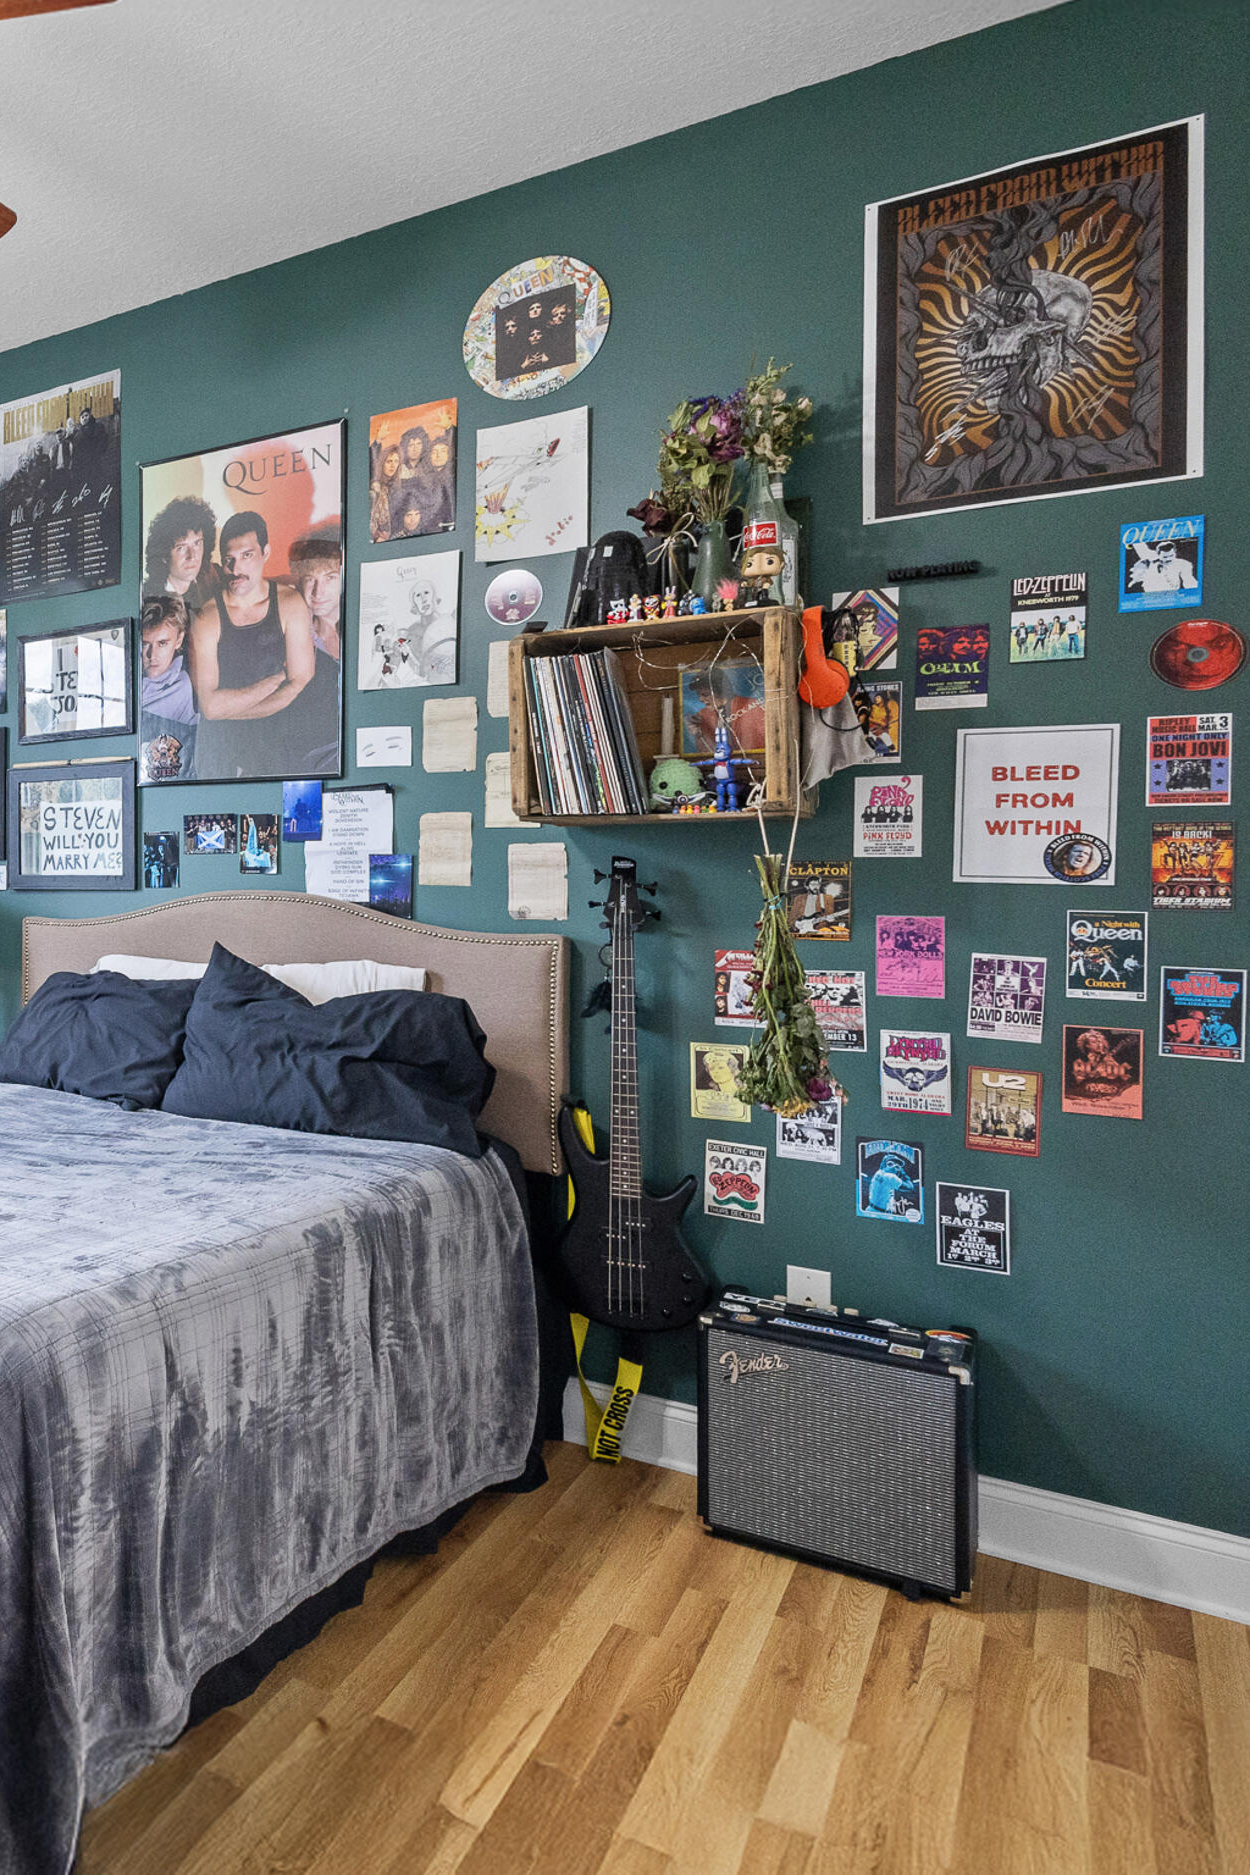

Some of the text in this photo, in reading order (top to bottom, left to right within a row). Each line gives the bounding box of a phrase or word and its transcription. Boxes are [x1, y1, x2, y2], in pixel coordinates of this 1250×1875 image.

[498, 267, 554, 305] QUEEN
[222, 444, 332, 495] QUEEN
[1122, 519, 1201, 549] QUEEN
[920, 661, 982, 675] CREAM
[1219, 716, 1228, 728] 3
[1151, 732, 1227, 742] ONE NIGHT ONLY
[1153, 741, 1226, 758] BON JOVI
[992, 765, 1080, 781] BLEED
[996, 792, 1074, 808] FROM
[44, 806, 121, 830] STEVEN
[985, 820, 1081, 835] WITHIN
[43, 832, 118, 850] WILL YOU
[43, 852, 122, 871] MARRY ME?
[790, 866, 848, 876] CLAPTON
[1071, 920, 1143, 943] Queen
[1085, 978, 1127, 989] Concert
[970, 1007, 1042, 1026] DAVID BOWIE
[982, 1072, 1026, 1091] U2
[709, 1143, 764, 1158] EXETER CIVIC HALL
[940, 1215, 1005, 1231] EAGLES
[951, 1240, 996, 1252] FORUM
[959, 1234, 986, 1244] THE
[950, 1246, 997, 1259] MARCH
[719, 1351, 790, 1384] Fender
[604, 1386, 634, 1431] CROSS
[596, 1429, 621, 1458] NOT
